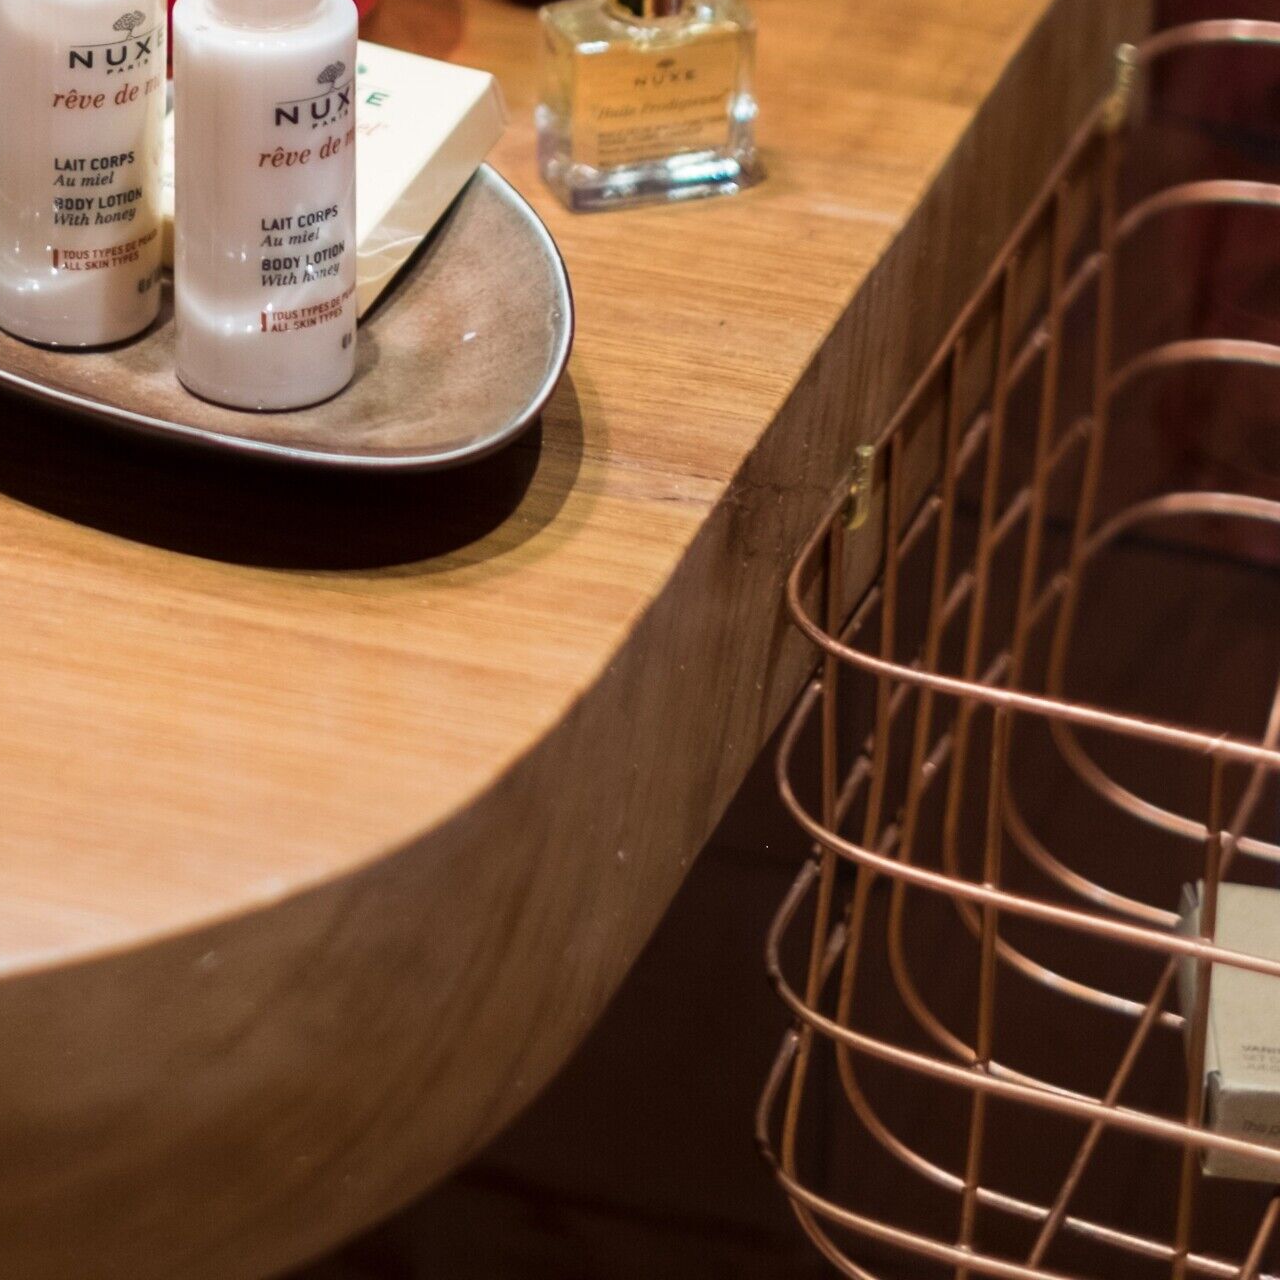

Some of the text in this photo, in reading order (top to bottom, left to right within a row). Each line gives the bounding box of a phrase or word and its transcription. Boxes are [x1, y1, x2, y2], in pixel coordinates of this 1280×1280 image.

[52, 88, 106, 110] rêve
[114, 83, 139, 106] de
[274, 86, 350, 127] NUX
[54, 151, 135, 171] LAIT CORPS
[258, 146, 311, 168] rêve
[319, 135, 341, 160] de
[53, 171, 115, 187] Au miel
[54, 187, 142, 211] BODY LOTION
[54, 207, 136, 226] With honey
[261, 205, 338, 231] LAIT CORPS
[260, 228, 320, 248] Au miel
[63, 249, 90, 260] TOUS
[93, 244, 124, 259] TYPES
[64, 251, 139, 271] ALL SKIN TYPES
[261, 240, 345, 271] BODY LOTION
[261, 263, 341, 287] With honey
[271, 311, 298, 321] TOUS
[301, 300, 329, 318] TYPES
[271, 307, 343, 332] ALL SKIN TYPES
